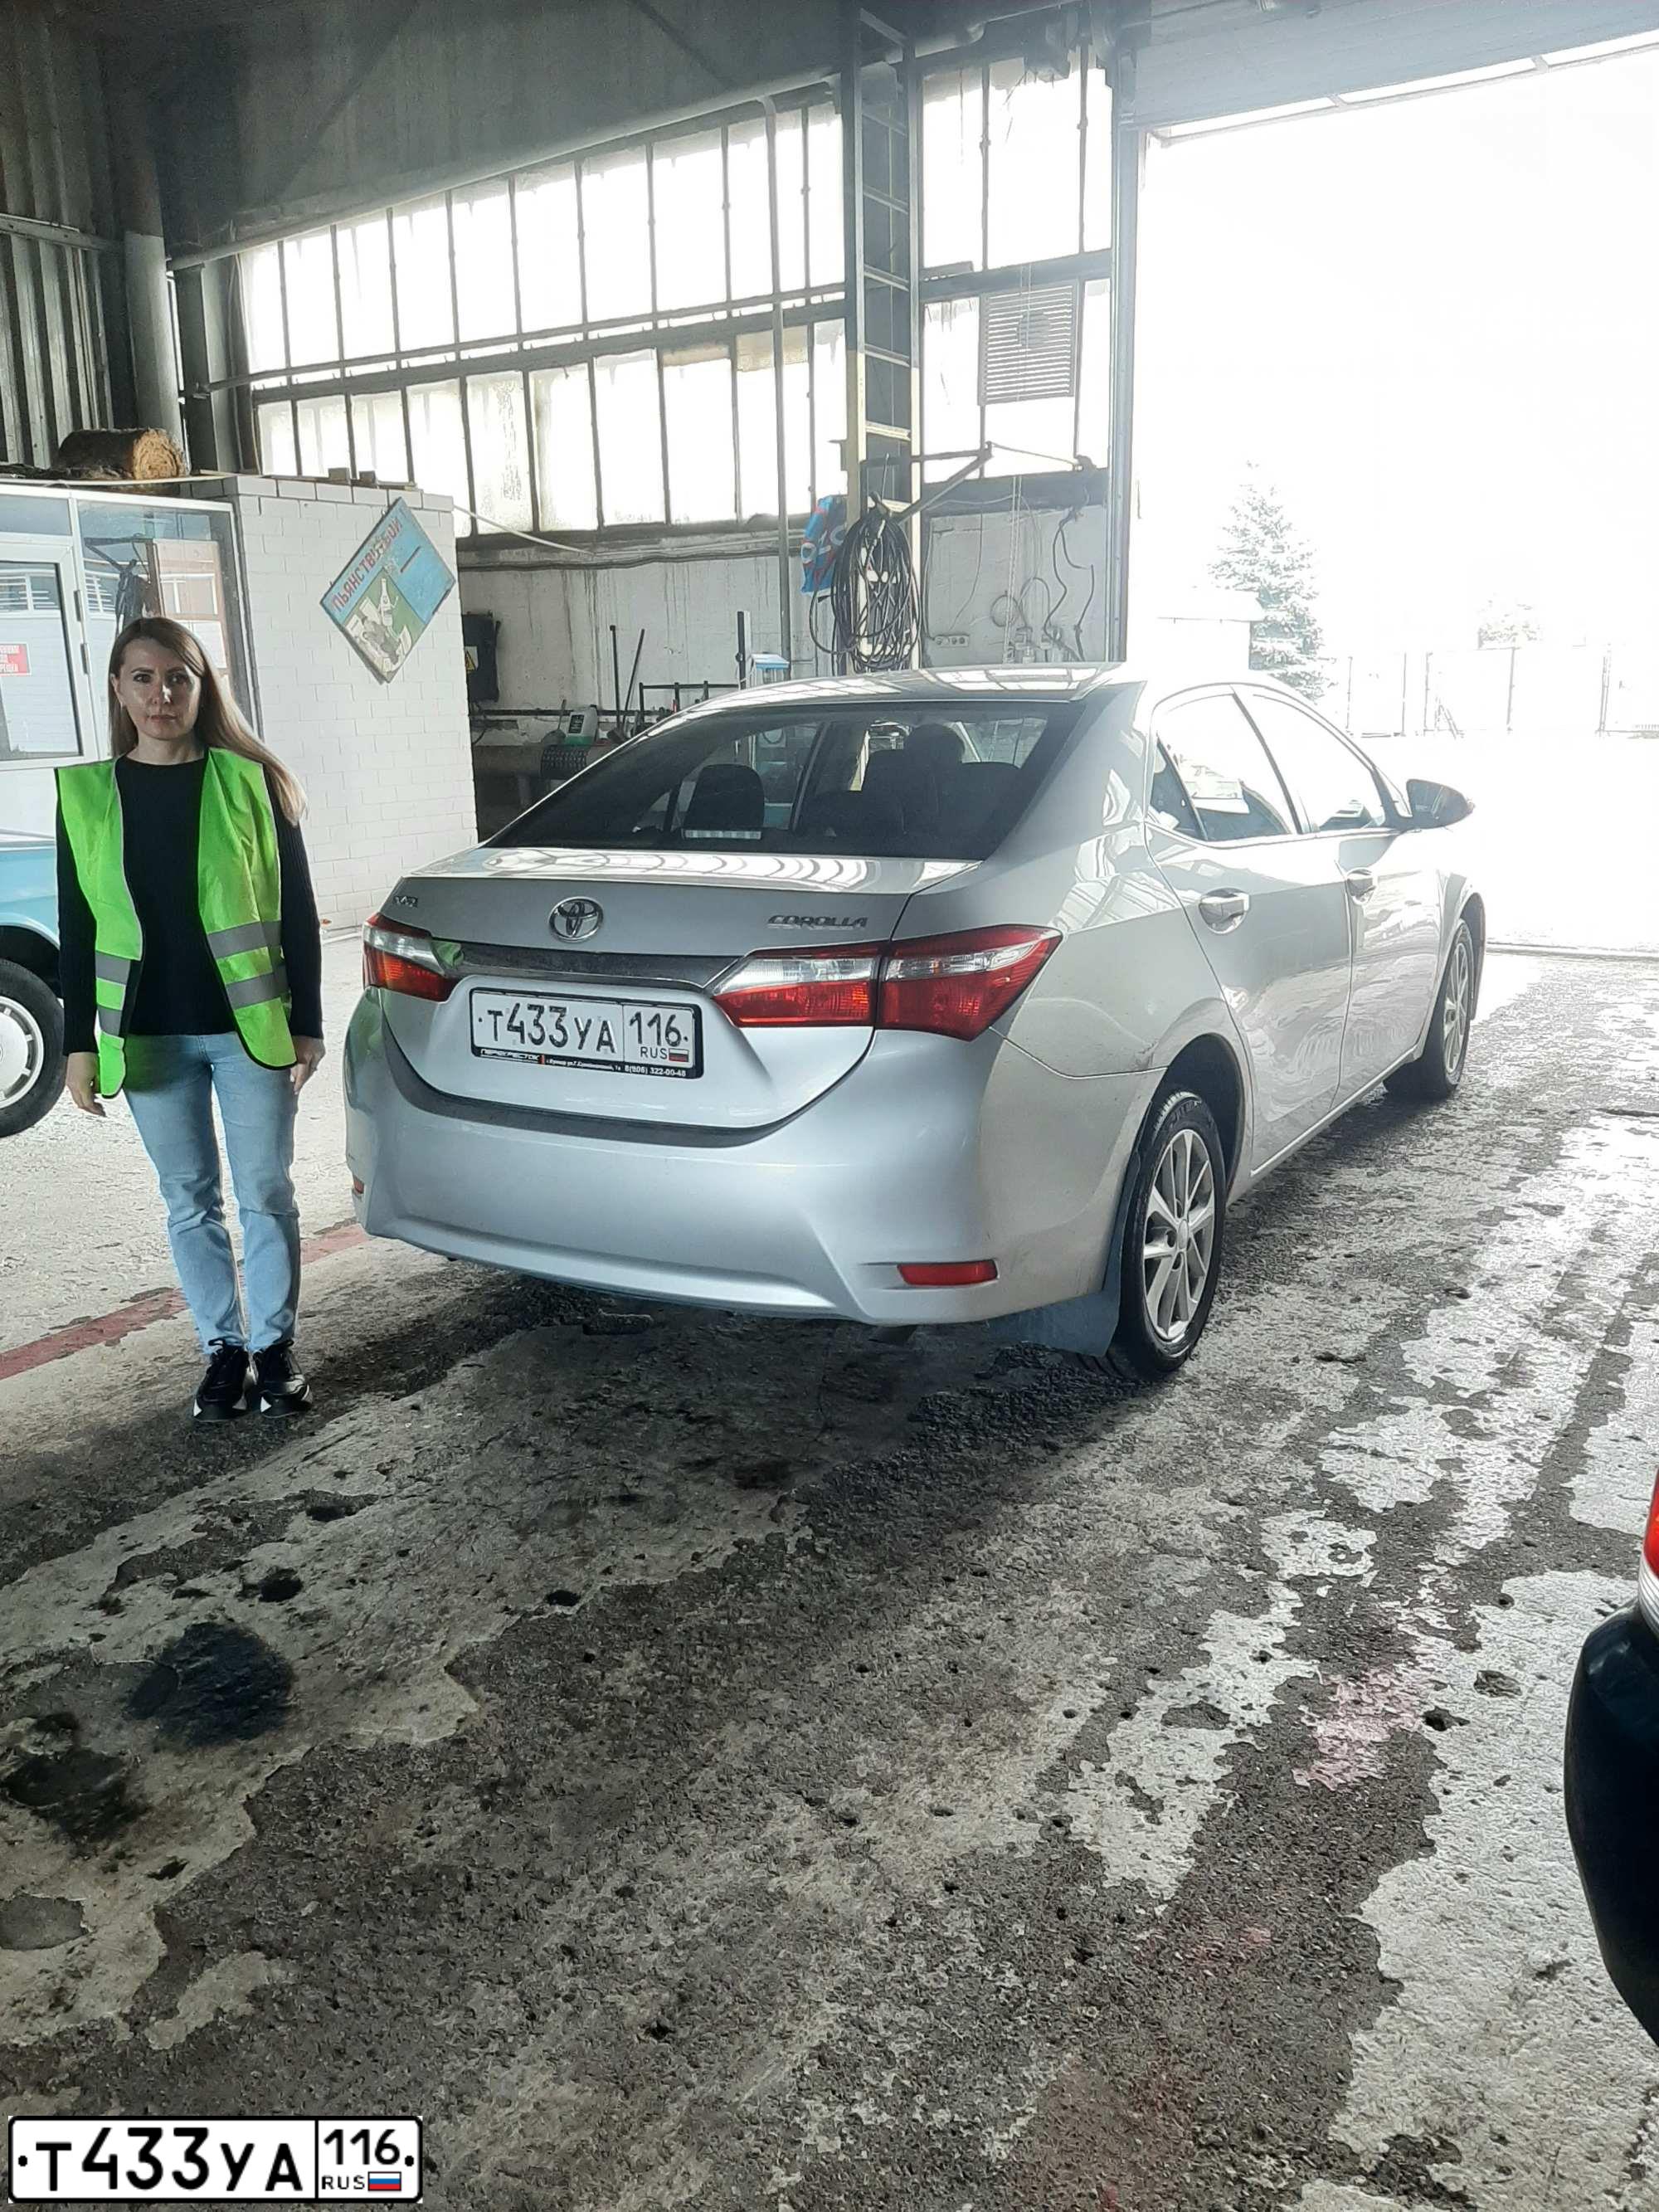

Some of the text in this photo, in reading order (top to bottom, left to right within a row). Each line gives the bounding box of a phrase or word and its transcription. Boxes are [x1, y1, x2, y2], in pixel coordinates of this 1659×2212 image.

[767, 914, 868, 928] COROLLA
[629, 1011, 682, 1047] 116
[640, 1046, 668, 1060] RUS
